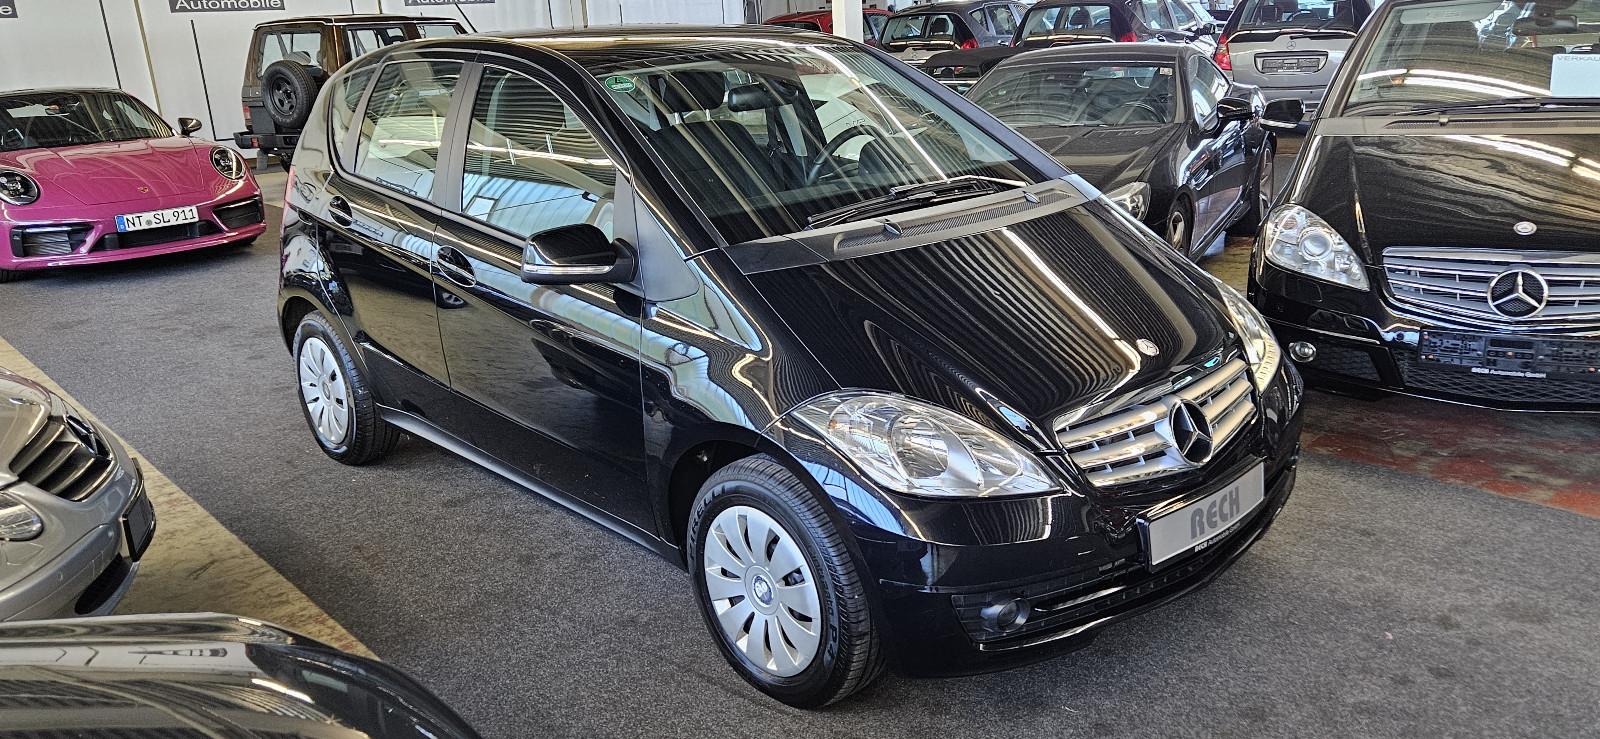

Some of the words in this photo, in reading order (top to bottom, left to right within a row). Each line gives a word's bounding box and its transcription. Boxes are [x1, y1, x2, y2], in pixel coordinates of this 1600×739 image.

[175, 0, 281, 10] Automobile
[125, 215, 143, 229] NT
[153, 212, 171, 225] SL
[172, 208, 197, 222] 911
[1190, 485, 1240, 540] RECH
